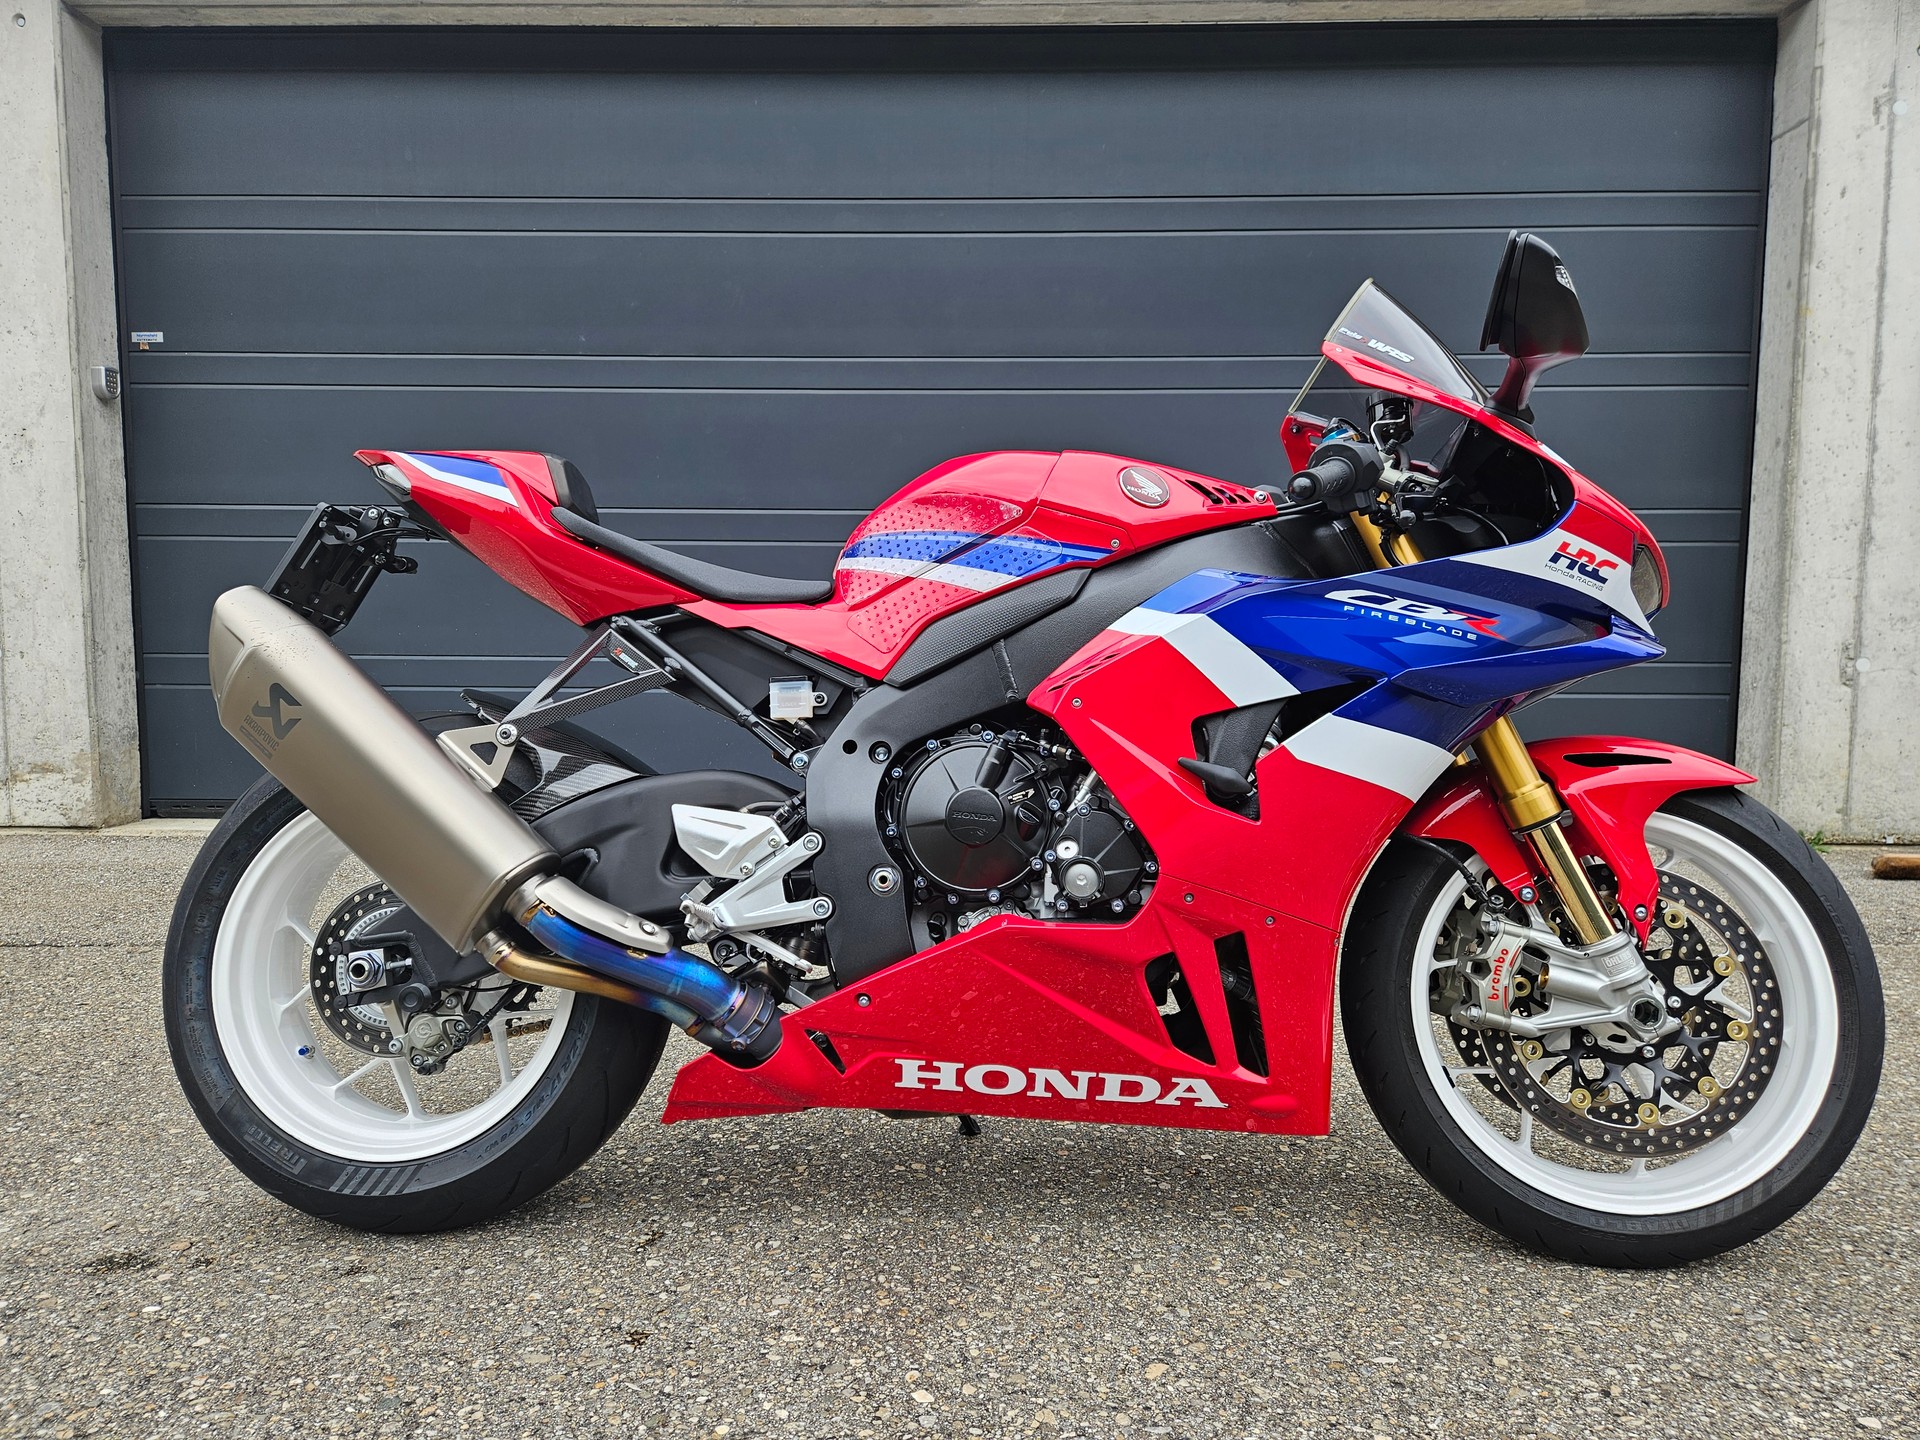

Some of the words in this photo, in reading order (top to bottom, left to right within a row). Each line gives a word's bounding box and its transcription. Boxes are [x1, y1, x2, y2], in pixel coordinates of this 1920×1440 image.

[1126, 485, 1162, 501] HONDA
[1544, 563, 1576, 580] Honda
[1575, 574, 1605, 592] RACING
[1548, 541, 1619, 585] HRC
[1344, 605, 1478, 640] FIREBLADE
[951, 810, 998, 823] HONDA
[1487, 948, 1509, 1001] brembo
[894, 1058, 1229, 1108] HONDA
